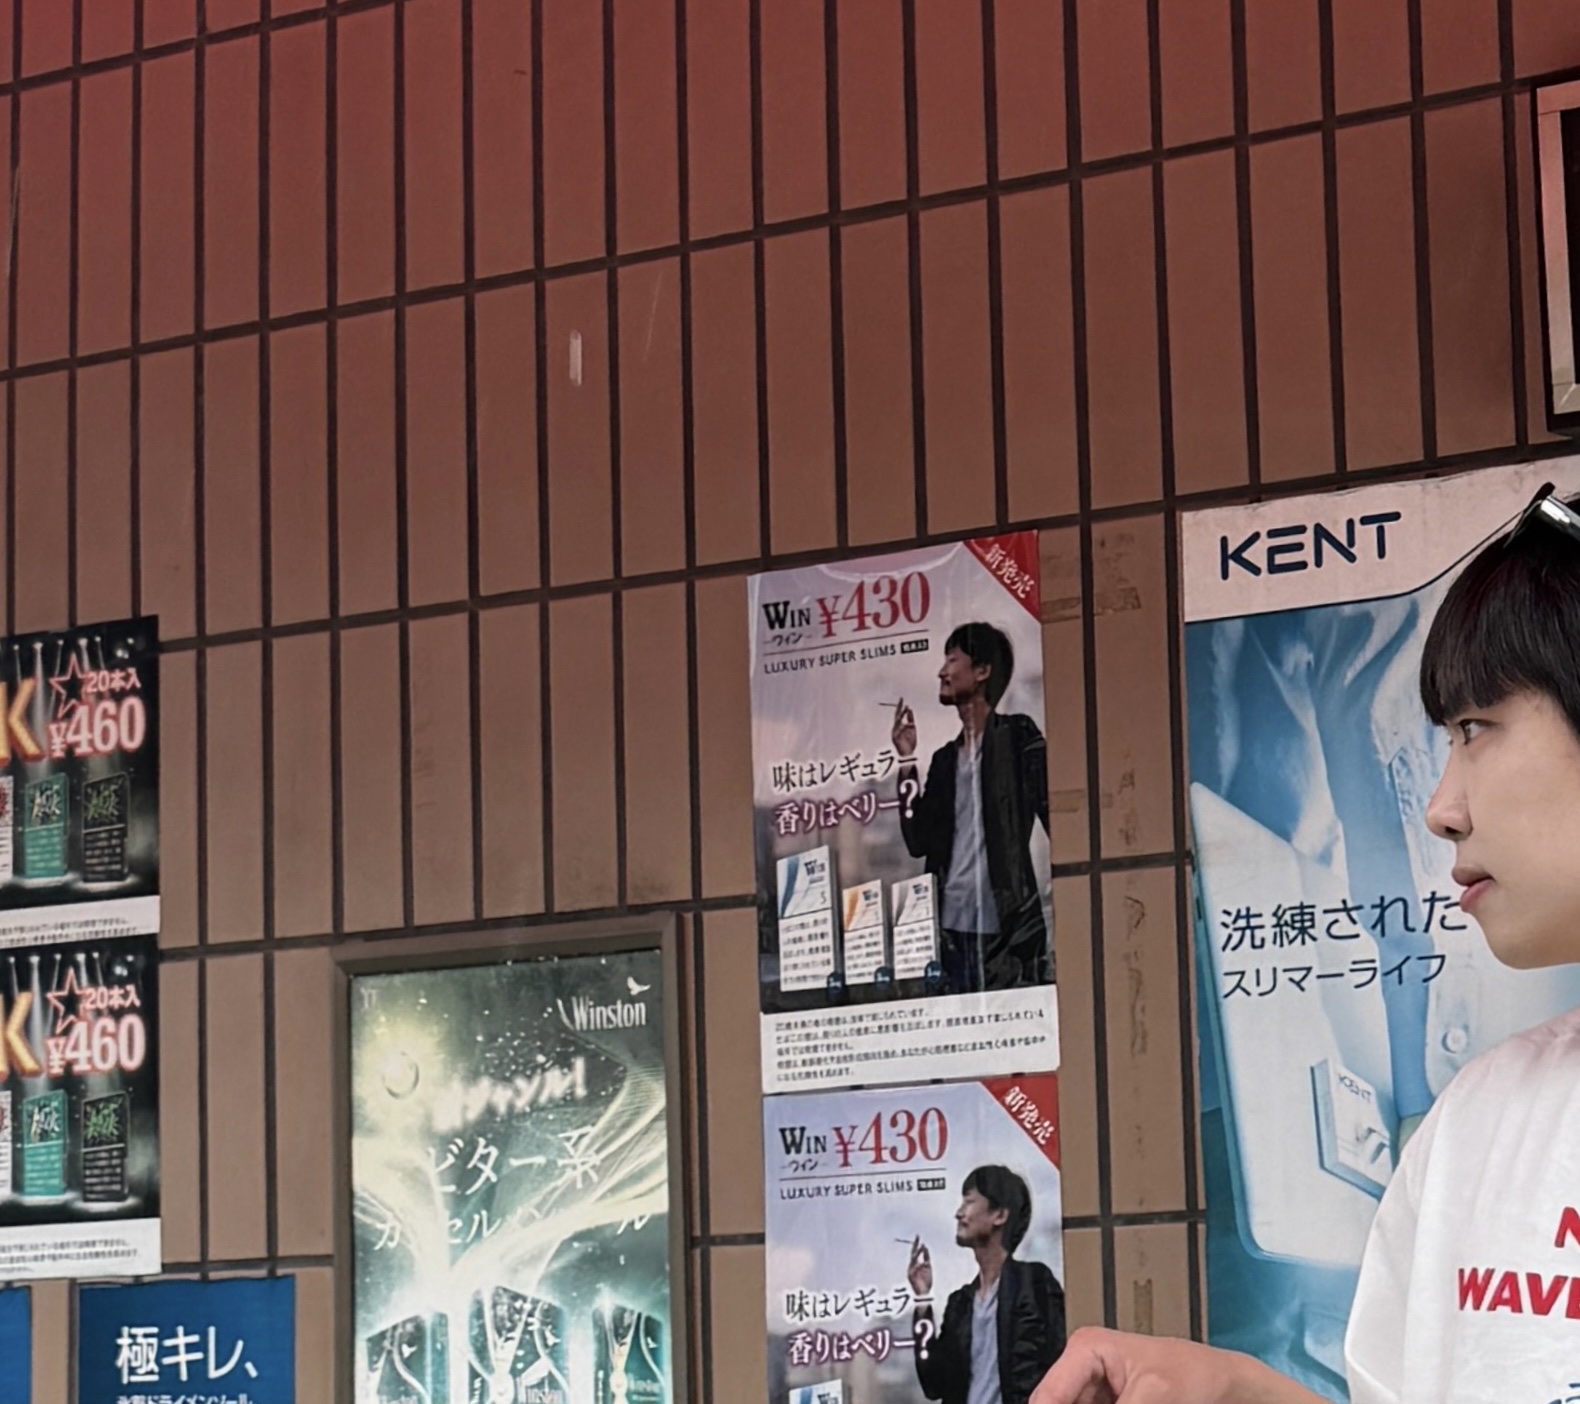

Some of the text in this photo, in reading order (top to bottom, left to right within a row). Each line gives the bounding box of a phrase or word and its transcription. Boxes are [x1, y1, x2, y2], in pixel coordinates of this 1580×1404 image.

[1219, 511, 1402, 581] KENT
[816, 571, 931, 638] ¥430
[764, 657, 815, 674] LUXURY
[819, 650, 857, 667] SUPER
[860, 644, 896, 660] SLIMS
[48, 696, 146, 761] ¥460
[771, 747, 920, 791] 味はレギュラー
[1220, 890, 1470, 954] 洗練された
[1222, 953, 1448, 1000] スリマーライフ
[571, 995, 647, 1031] Winston
[46, 1014, 146, 1076] ¥460
[832, 1107, 948, 1168] ¥430
[780, 1185, 831, 1200] LUXURY
[834, 1182, 872, 1196] SUPER
[877, 1180, 913, 1193] SLIMS
[785, 1285, 936, 1321] 味はレギュラー
[115, 1325, 258, 1385] 極キレ、
